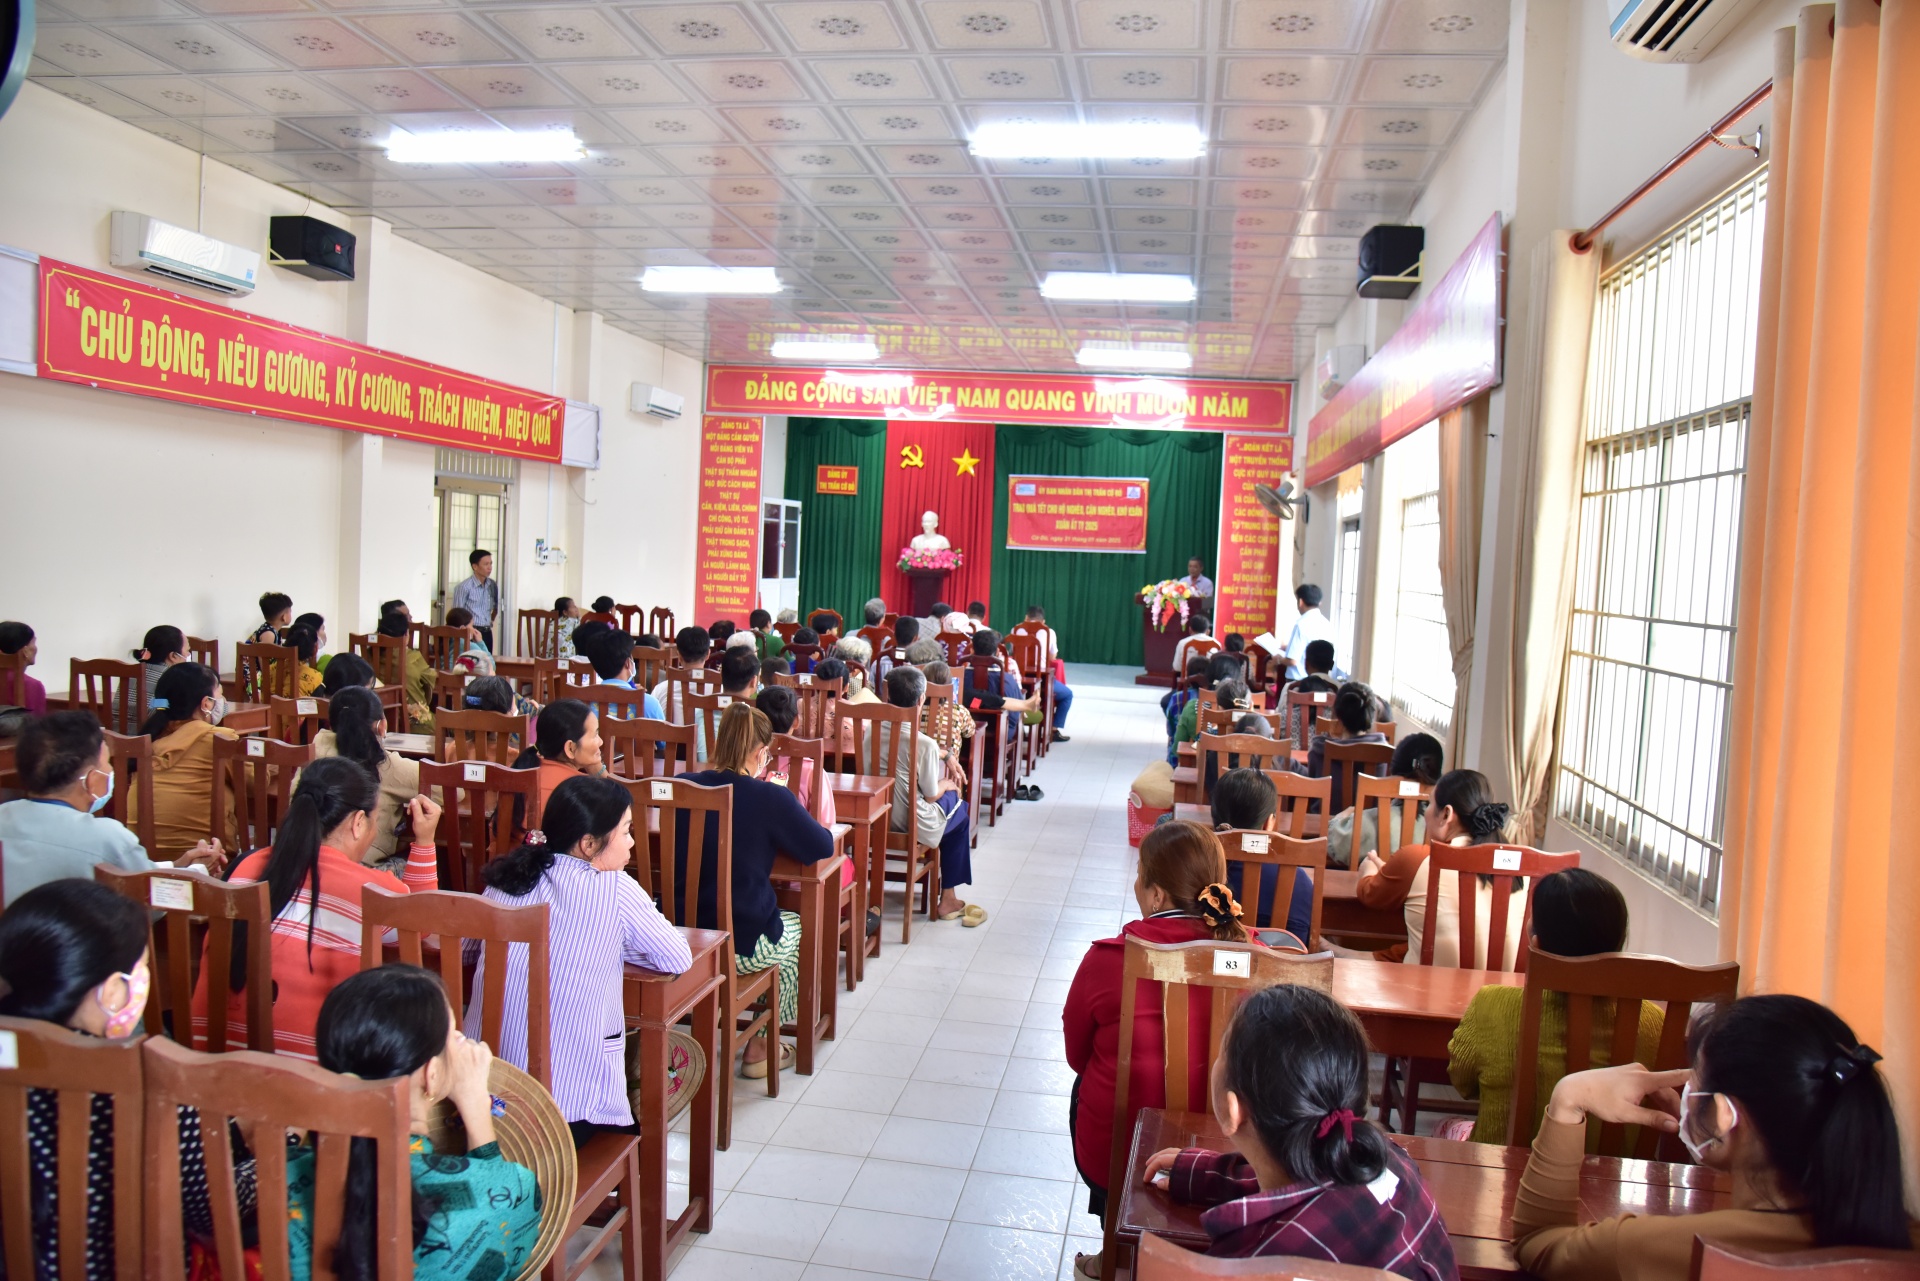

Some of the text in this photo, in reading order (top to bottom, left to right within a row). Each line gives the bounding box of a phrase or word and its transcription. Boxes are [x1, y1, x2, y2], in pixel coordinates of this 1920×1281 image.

[140, 314, 210, 385] ĐỘNG,
[217, 333, 259, 389] NÊU
[264, 349, 330, 408] GƯƠNG,
[335, 356, 358, 407] KỶ
[361, 372, 414, 423] CƯƠNG,
[419, 383, 460, 428] TRÁCH
[462, 394, 502, 441] NHIỆM,
[505, 402, 528, 447] HIỆU
[745, 373, 798, 402] ĐẢNG
[802, 378, 856, 408] CỘNG
[906, 381, 952, 412] VIỆT
[956, 386, 1000, 409] NAM
[1005, 388, 1076, 413] QUANG
[1081, 391, 1132, 414] VINH
[1202, 391, 1249, 418] NĂM
[706, 432, 716, 441] MỘT
[717, 431, 730, 440] ĐẢNG
[720, 442, 733, 452] ĐẢNG
[1229, 454, 1242, 465] MỘT
[1057, 486, 1071, 495] NHÂN
[1013, 503, 1025, 512] TRAO
[1047, 504, 1058, 514] CHO
[1056, 518, 1070, 530] XUÂN
[1225, 960, 1238, 970] 83
